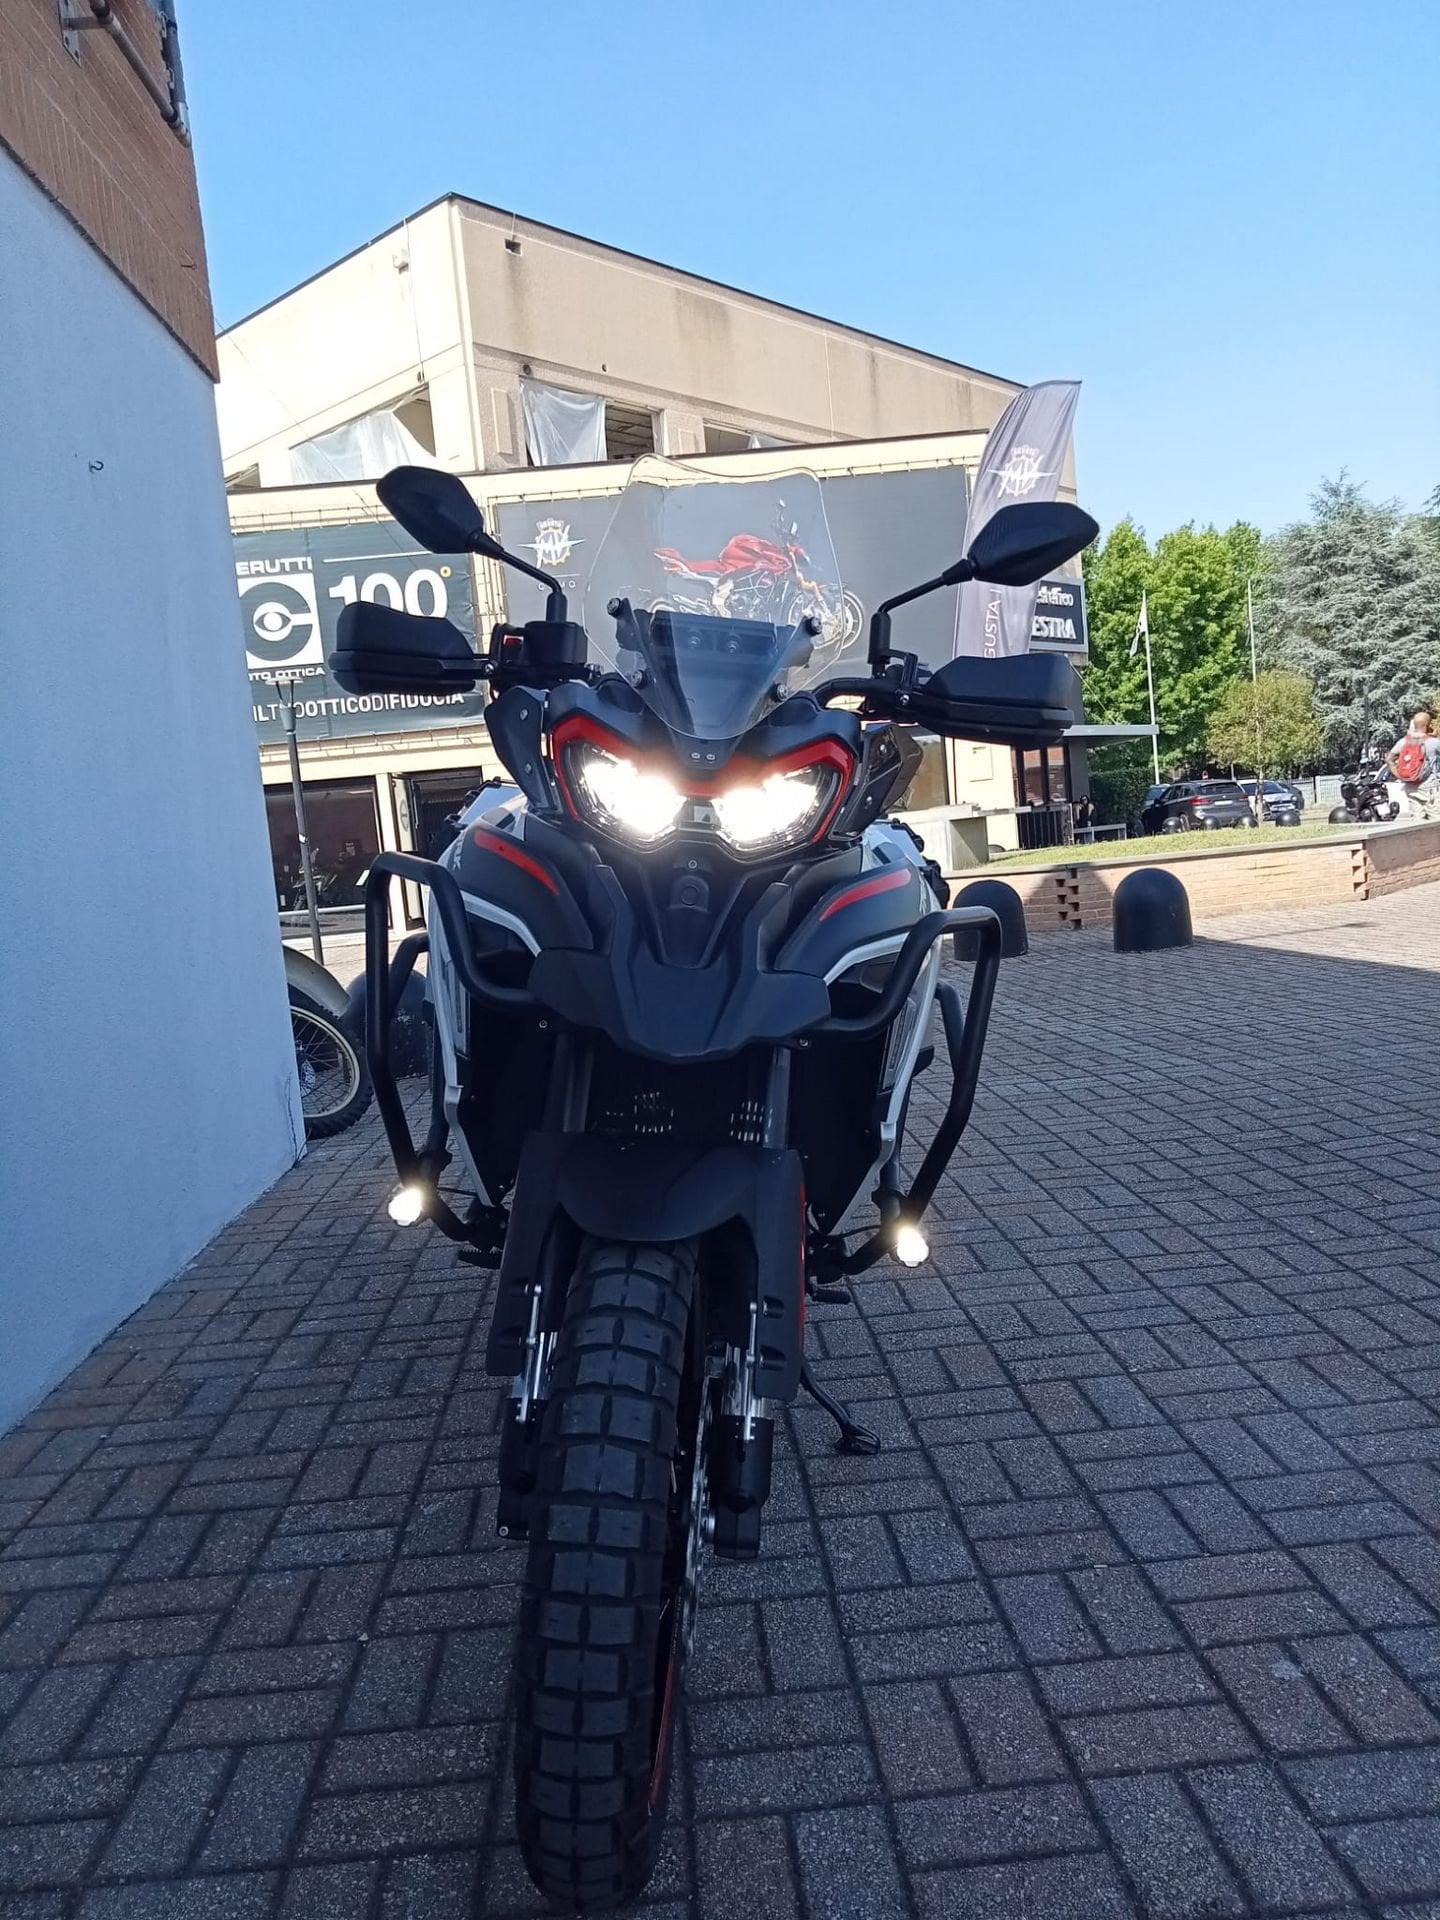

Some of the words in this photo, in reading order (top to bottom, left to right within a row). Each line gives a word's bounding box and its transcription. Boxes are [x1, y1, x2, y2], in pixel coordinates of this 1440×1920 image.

[235, 556, 313, 576] ERUTTI
[984, 600, 1002, 659] GUSTA
[1031, 616, 1077, 640] ESTRA
[275, 667, 326, 682] OTTICA
